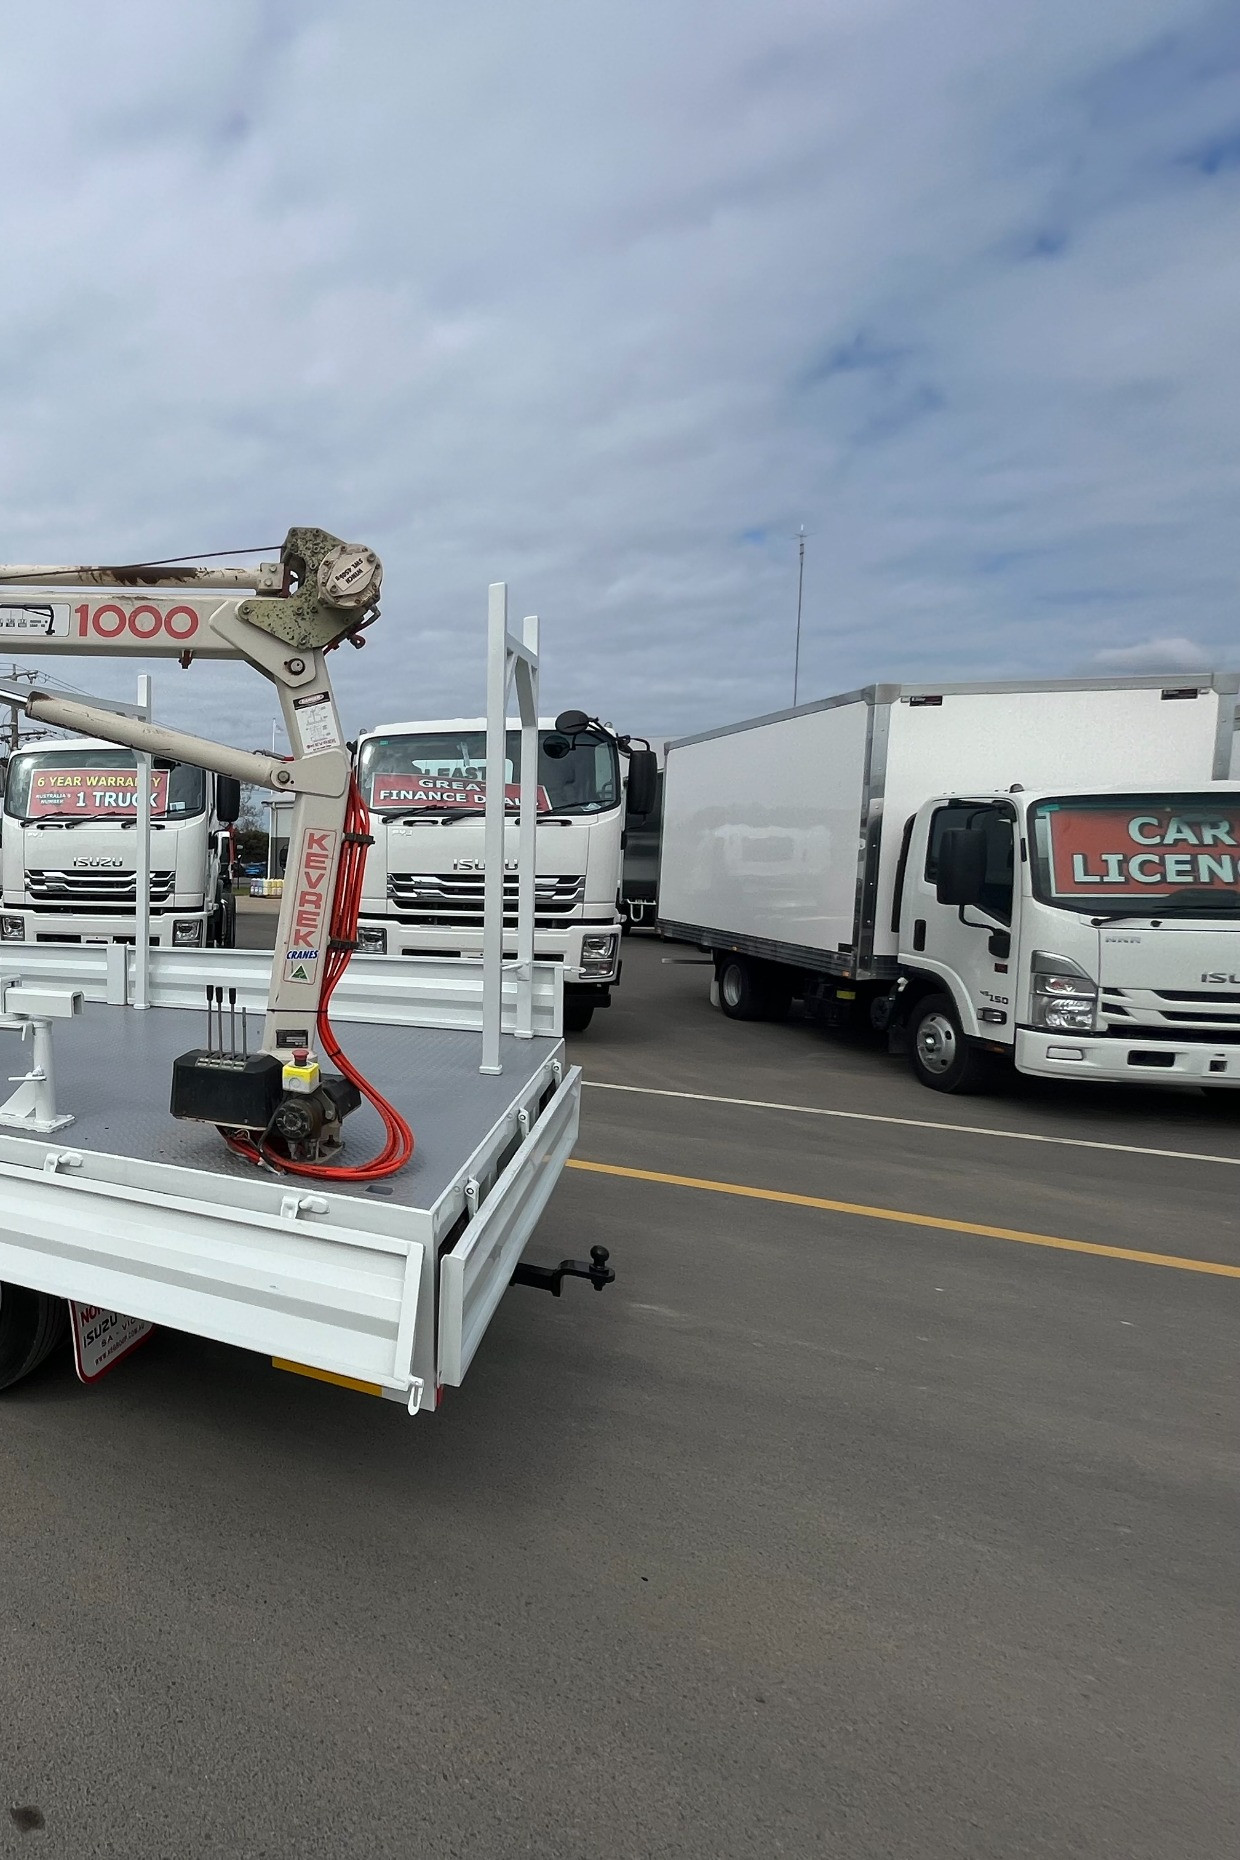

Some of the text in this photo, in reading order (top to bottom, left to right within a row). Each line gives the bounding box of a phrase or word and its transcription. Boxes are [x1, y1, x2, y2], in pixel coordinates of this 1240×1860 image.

[75, 604, 198, 639] 1000
[37, 776, 161, 788] 6 YEAR WARRAY
[419, 779, 486, 792] GREA
[76, 791, 86, 807] 1
[380, 790, 466, 802] FINANCE
[1128, 816, 1238, 845] CAR
[73, 857, 123, 867] ISUZU
[453, 859, 519, 871] ISUU
[1073, 854, 1240, 883] LICEN
[293, 833, 331, 948] KEVREK
[286, 950, 319, 960] CRANES
[83, 1313, 118, 1349] ISUZU
